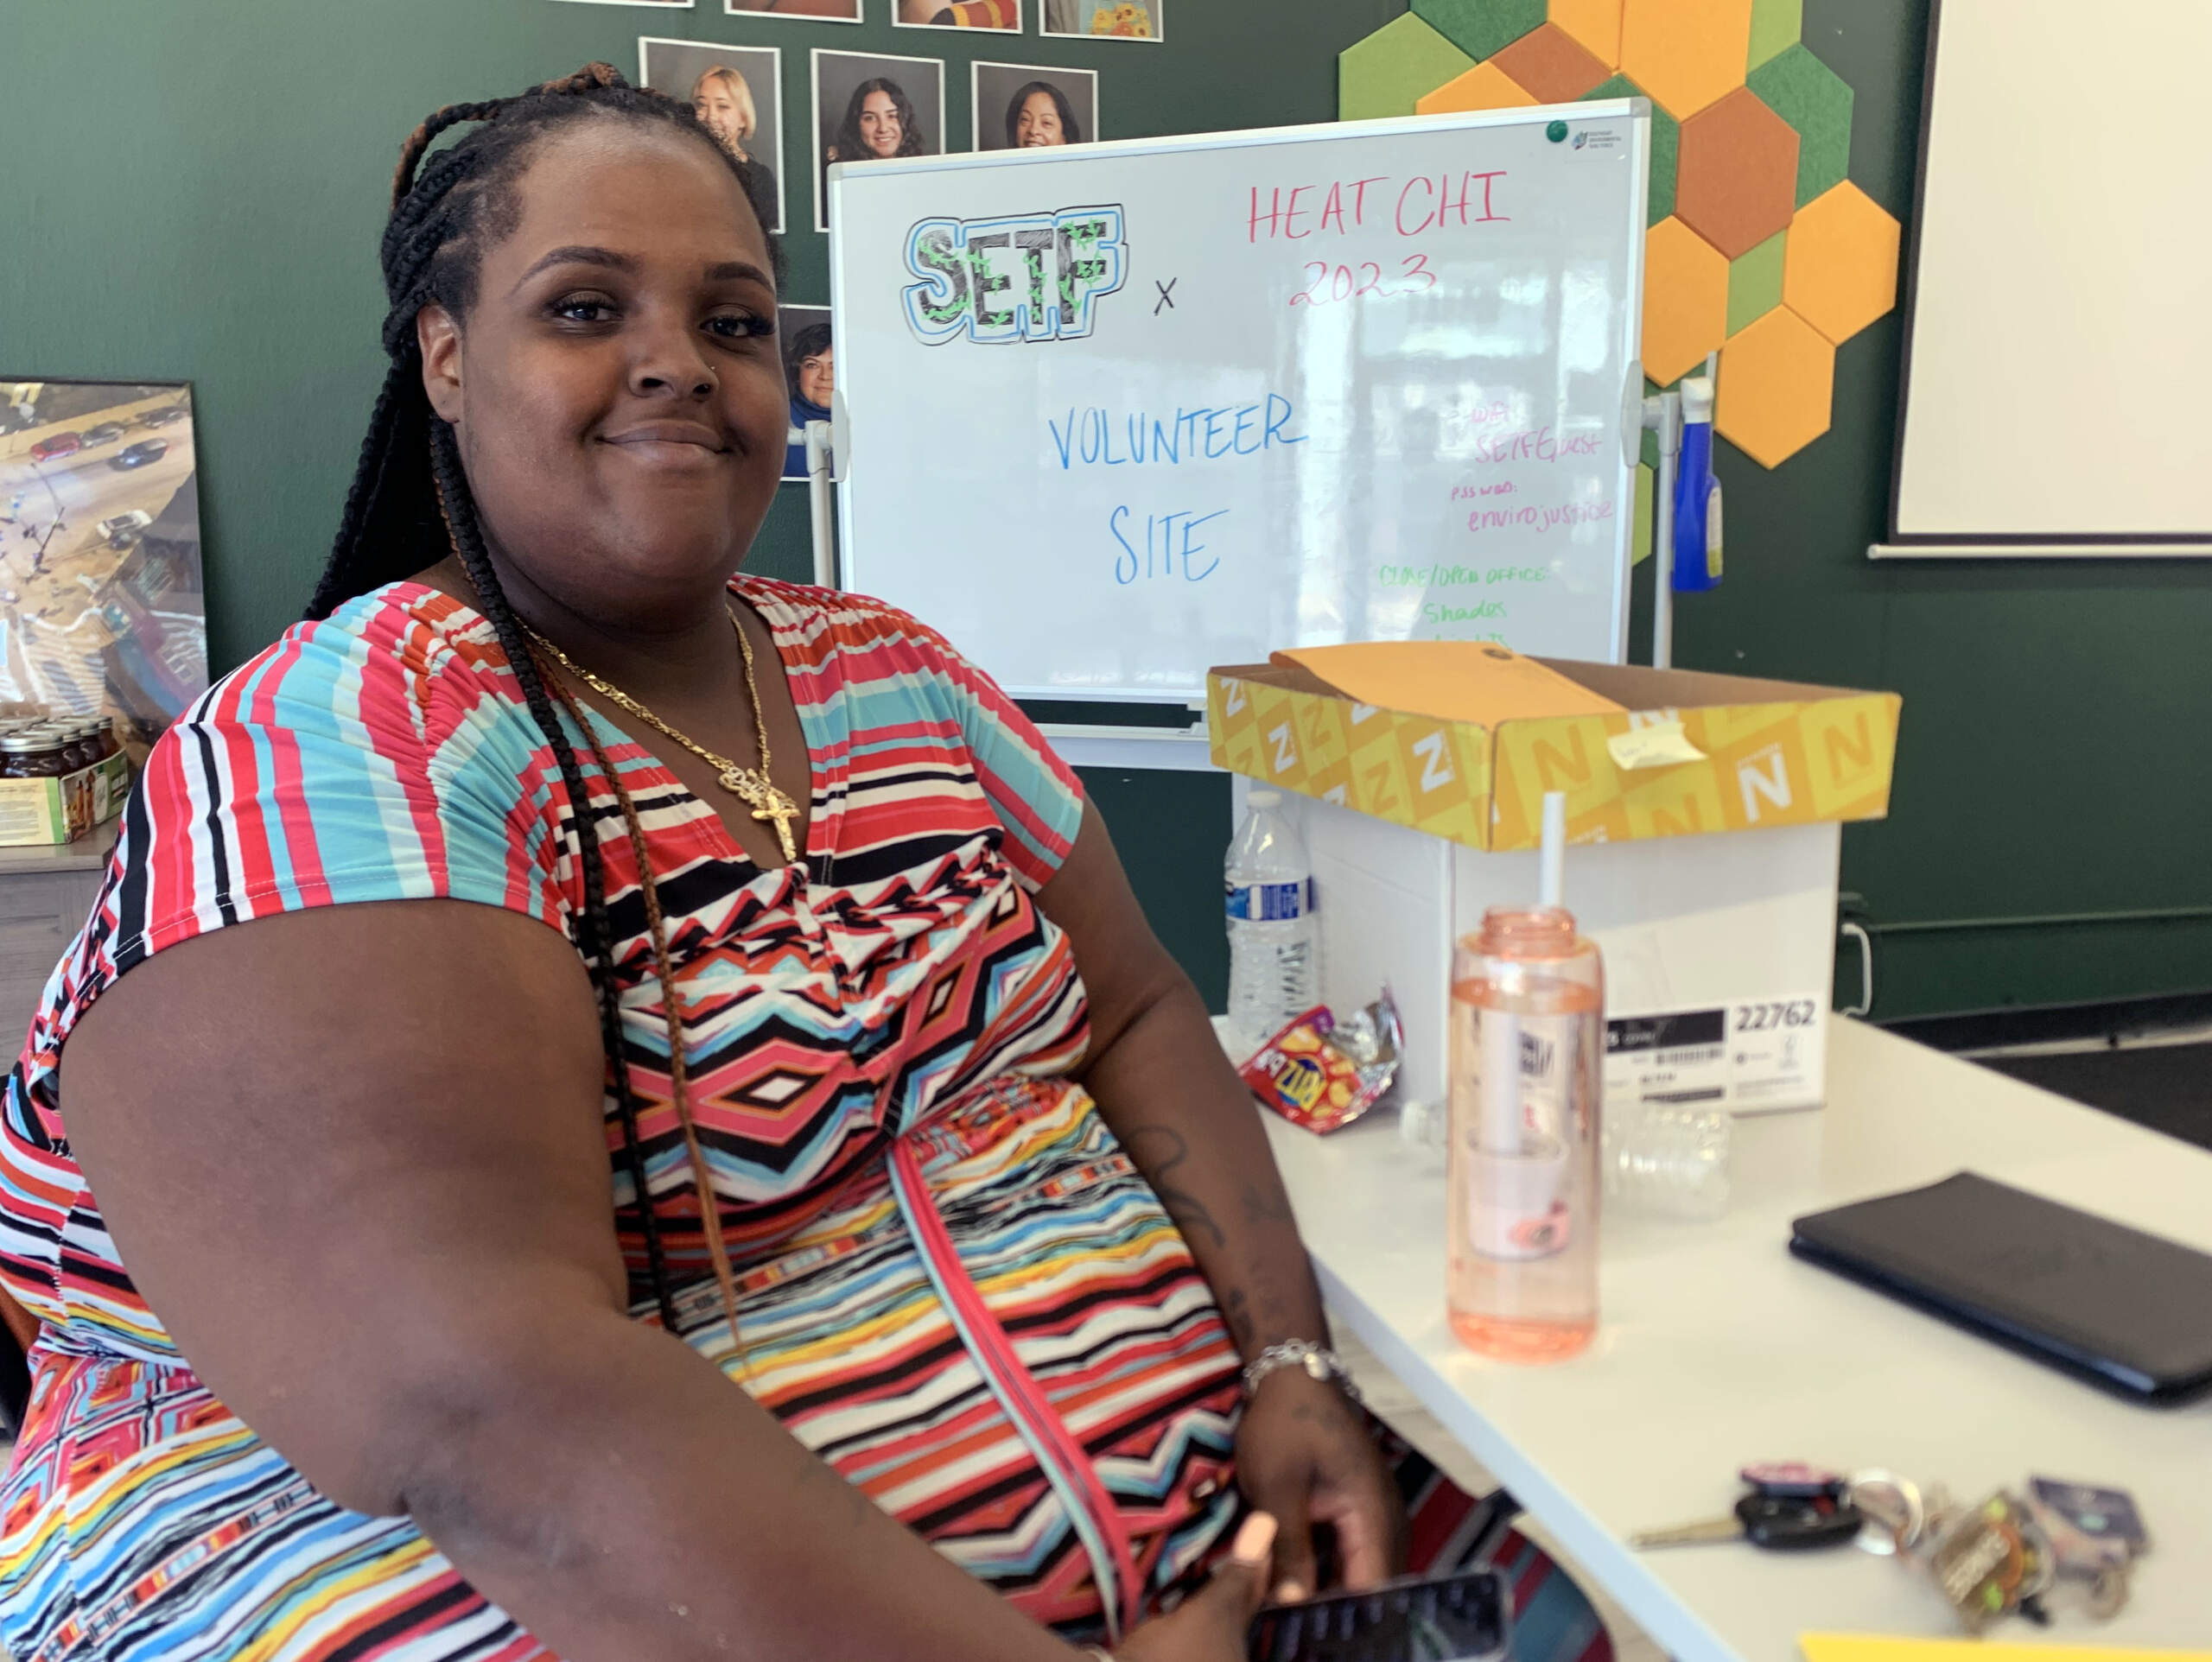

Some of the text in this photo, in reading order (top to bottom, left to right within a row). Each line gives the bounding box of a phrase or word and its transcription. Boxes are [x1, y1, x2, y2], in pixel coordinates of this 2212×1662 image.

[1247, 171, 1511, 244] HEAT CHI
[914, 218, 1113, 330] SETF
[1288, 254, 1437, 306] 2023
[1048, 393, 1310, 469] VOLUNTEER
[1109, 504, 1230, 585] SITE
[1468, 501, 1613, 533] envirojustice
[1738, 752, 1793, 823] N
[1735, 999, 1816, 1032] 22762
